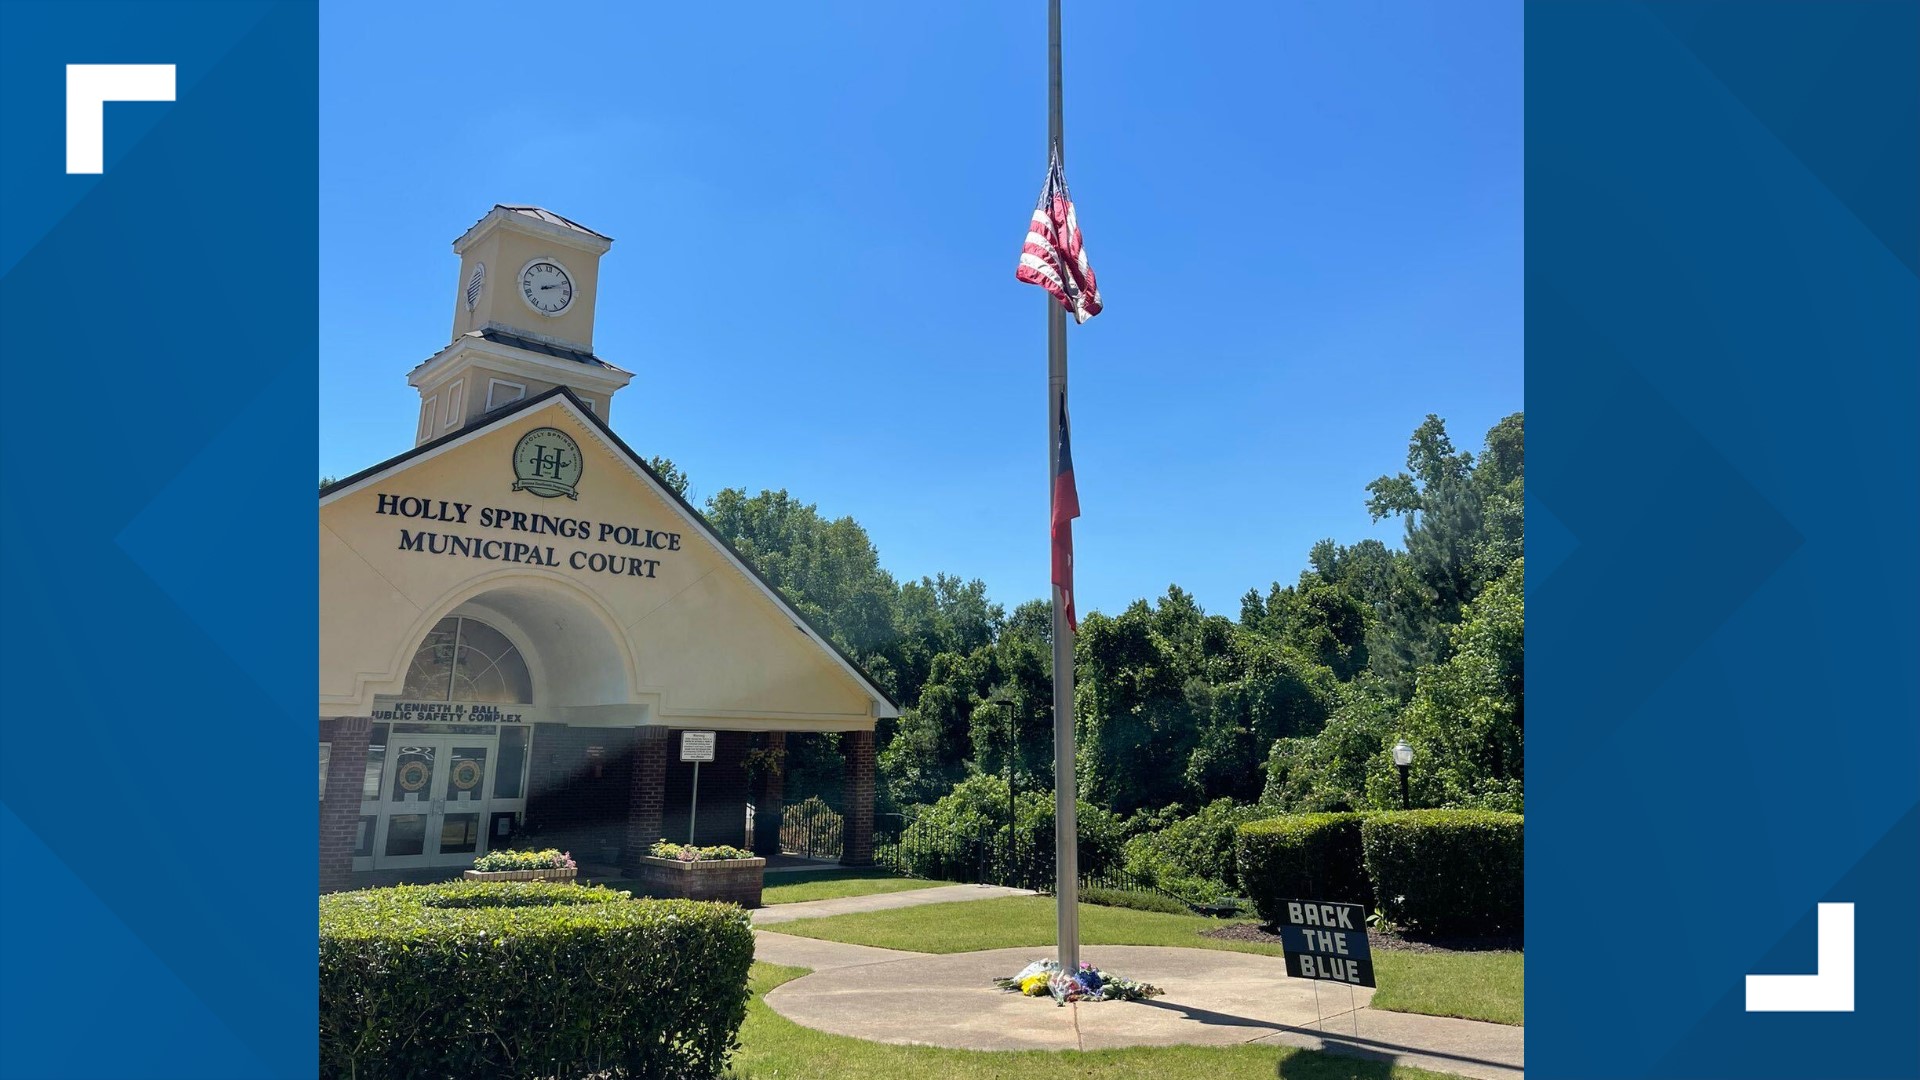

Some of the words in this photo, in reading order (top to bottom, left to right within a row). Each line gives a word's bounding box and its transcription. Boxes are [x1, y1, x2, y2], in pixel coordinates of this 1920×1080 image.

[525, 432, 544, 446] HOLLY
[547, 432, 575, 451] SPRINGS
[376, 493, 472, 523] HOLLY
[480, 507, 590, 540] SPRINGS
[598, 522, 681, 551] POLICE
[398, 529, 560, 567] MUNICIPAL
[569, 551, 660, 578] COURT
[395, 703, 450, 713] KENNETH
[455, 705, 467, 714] N.
[472, 705, 500, 714] BALL
[417, 712, 464, 722] SAFETY
[468, 713, 522, 723] COMPLEX
[1288, 902, 1354, 929] BACK
[1302, 929, 1349, 955] THE
[1299, 954, 1360, 983] BLUE
